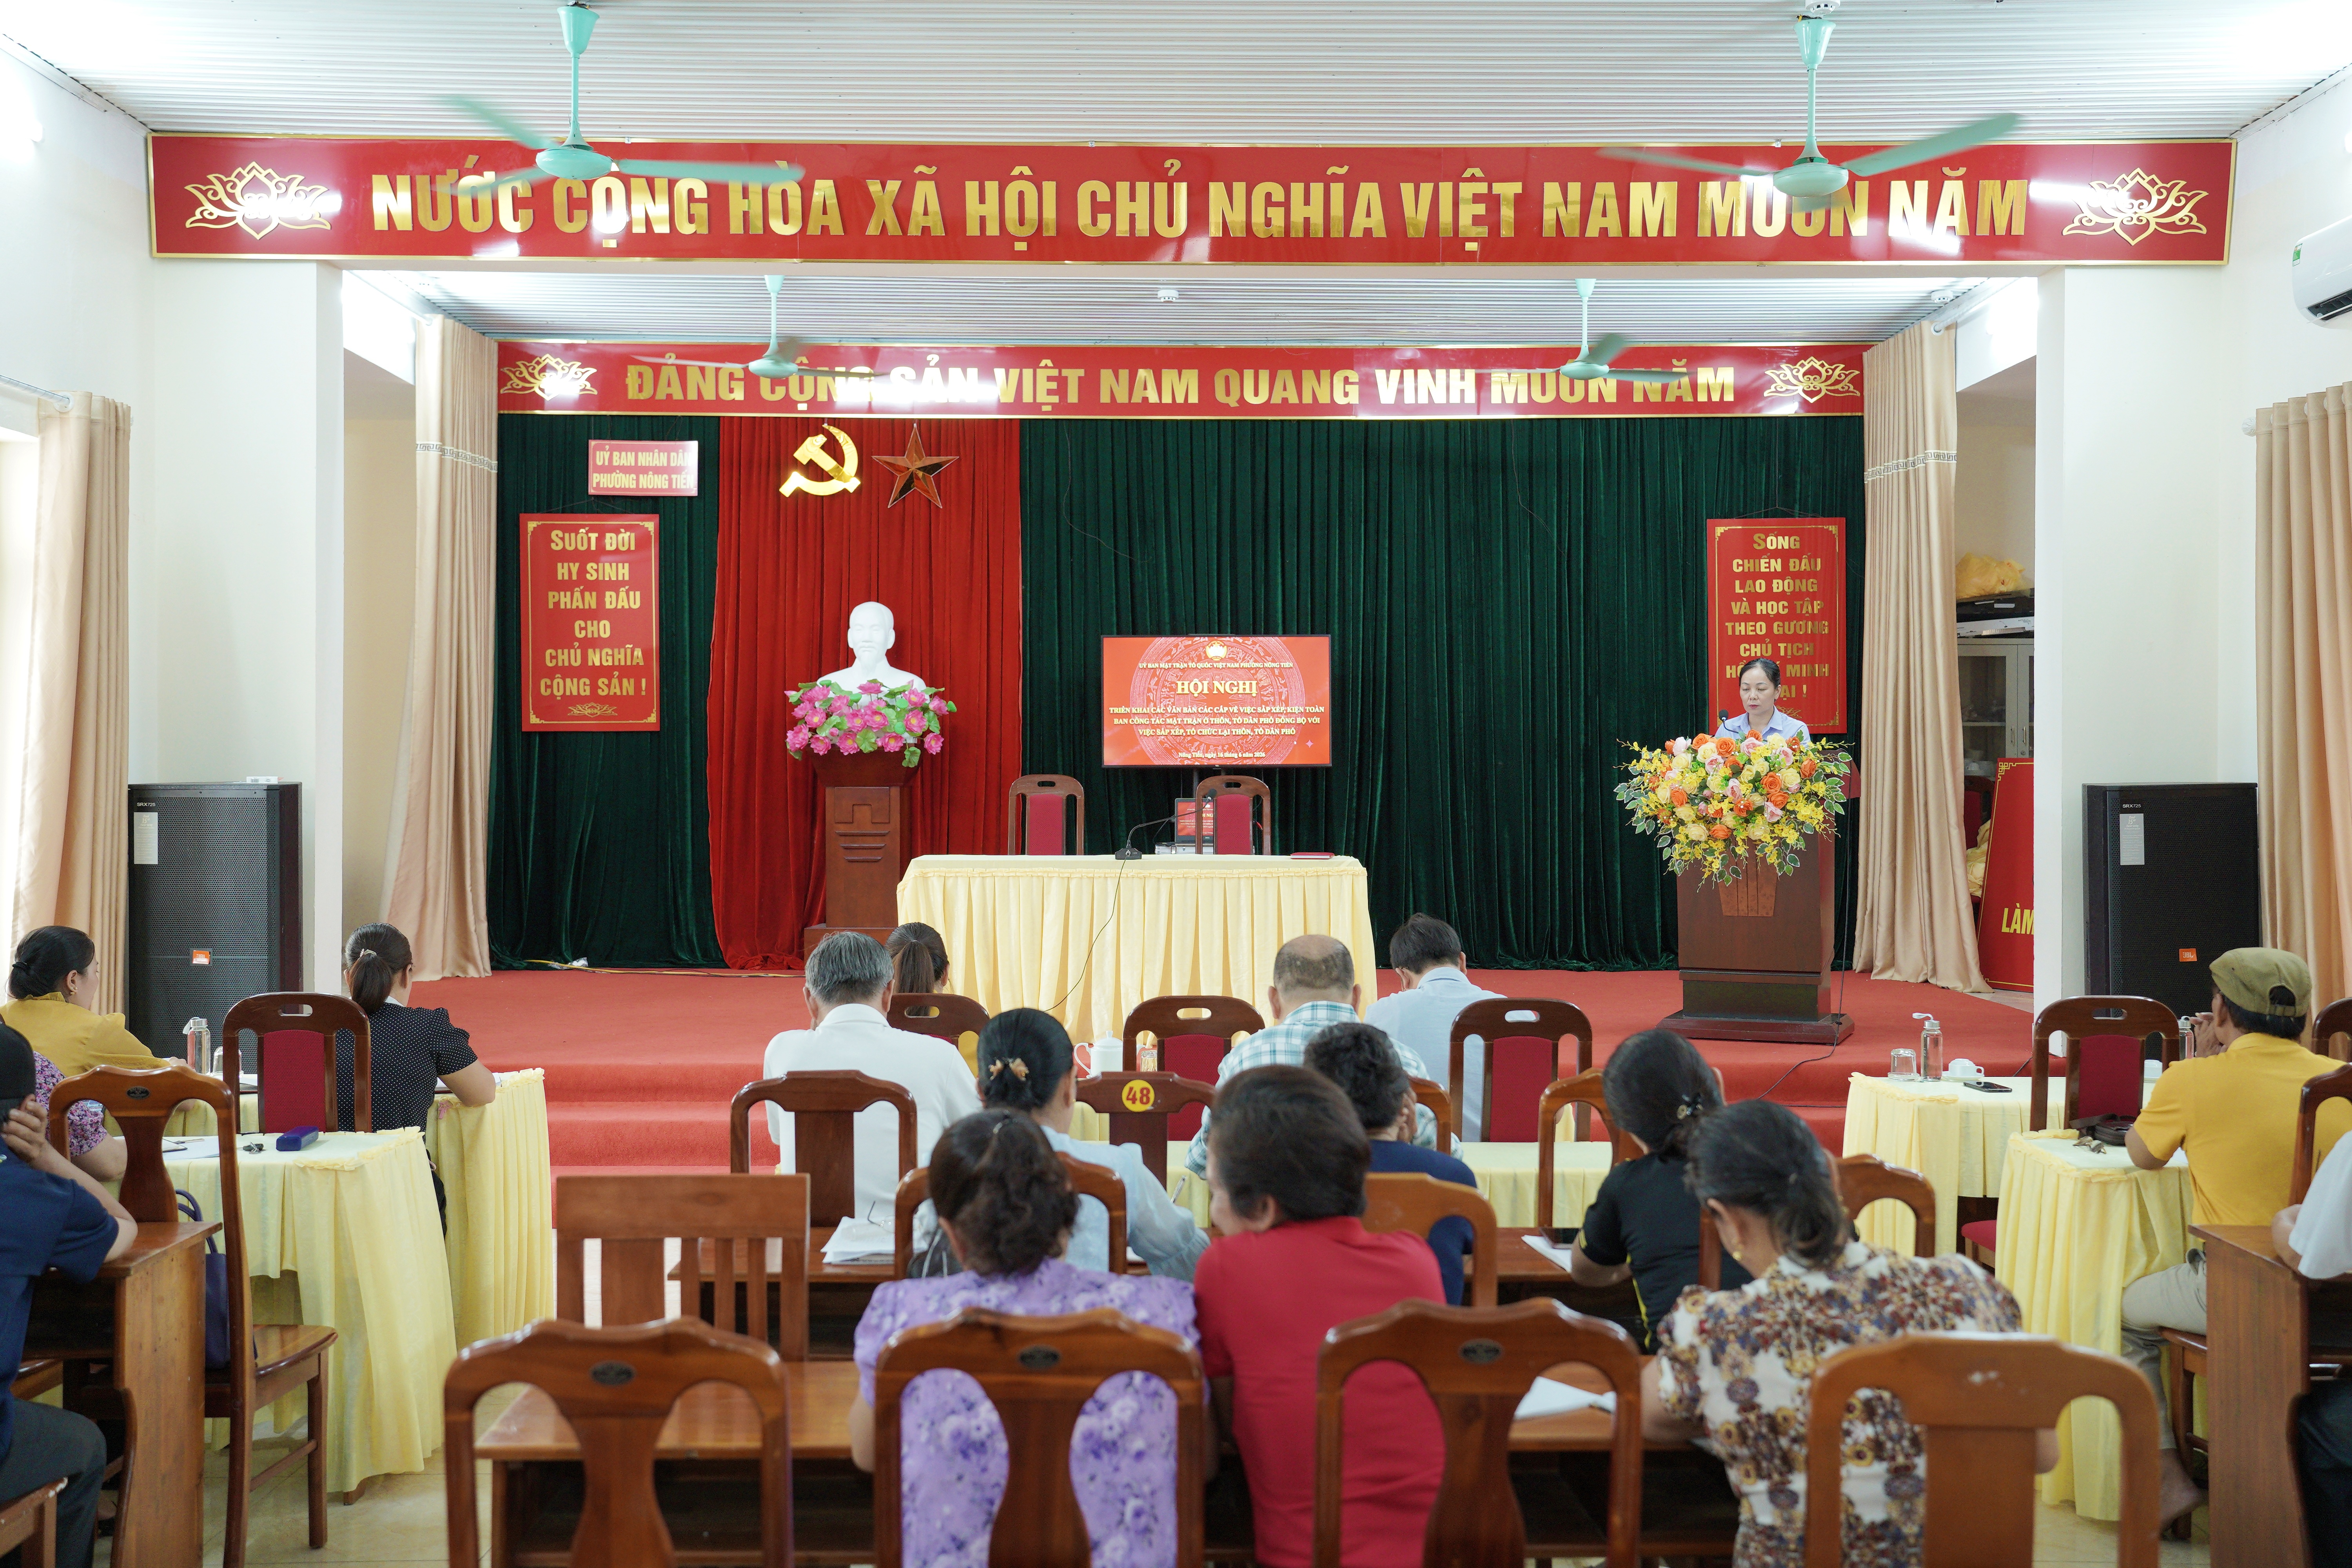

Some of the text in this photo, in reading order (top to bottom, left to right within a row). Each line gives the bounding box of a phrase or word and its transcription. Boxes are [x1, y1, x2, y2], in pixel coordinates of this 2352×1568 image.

[372, 155, 534, 233] NƯỚC
[728, 160, 844, 235] HÒA
[866, 165, 945, 236] XÃ
[965, 166, 1057, 250] HỘI
[1077, 158, 1187, 237] CHỦ
[1208, 165, 1387, 238] NGHĨA
[1399, 168, 1523, 251] VIỆT
[1543, 181, 1678, 237] NAM
[1888, 167, 2028, 236] NĂM
[626, 353, 744, 401] ĐẢNG
[889, 354, 978, 403] SẢN
[994, 359, 1085, 411] VIỆT
[1101, 369, 1198, 404] NAM
[1215, 368, 1359, 406] QUANG
[1375, 368, 1475, 405] VINH
[1633, 359, 1734, 402] NĂM
[596, 445, 610, 465] UỶ
[613, 451, 635, 466] BAN
[638, 449, 667, 466] NHÂN
[593, 470, 636, 488] PHƯỜNG
[639, 471, 668, 488] NÔNG
[550, 528, 635, 551] SUỐT ĐỜI
[1753, 531, 1800, 550] SỐNG
[557, 562, 629, 580] HY SINH
[1733, 553, 1821, 572] CHIẾN ĐẤU
[1735, 576, 1818, 595] LAO ĐỘNG
[548, 586, 641, 609] PHẤN ĐẤU
[1731, 597, 1824, 617] VÀ HỌC TẬP
[574, 620, 611, 638] CHO
[1726, 620, 1829, 635] THEO GƯƠNG
[546, 642, 644, 666] CHỦ NGHĨA
[1740, 639, 1814, 659] CHỦ TỊCH
[1786, 664, 1829, 677] MINH
[541, 675, 590, 700] CỘNG
[598, 671, 635, 696] SẢN
[1176, 679, 1258, 697] HỘI NGHỊ
[1297, 717, 1307, 725] BỘ
[1126, 1087, 1151, 1105] 48
